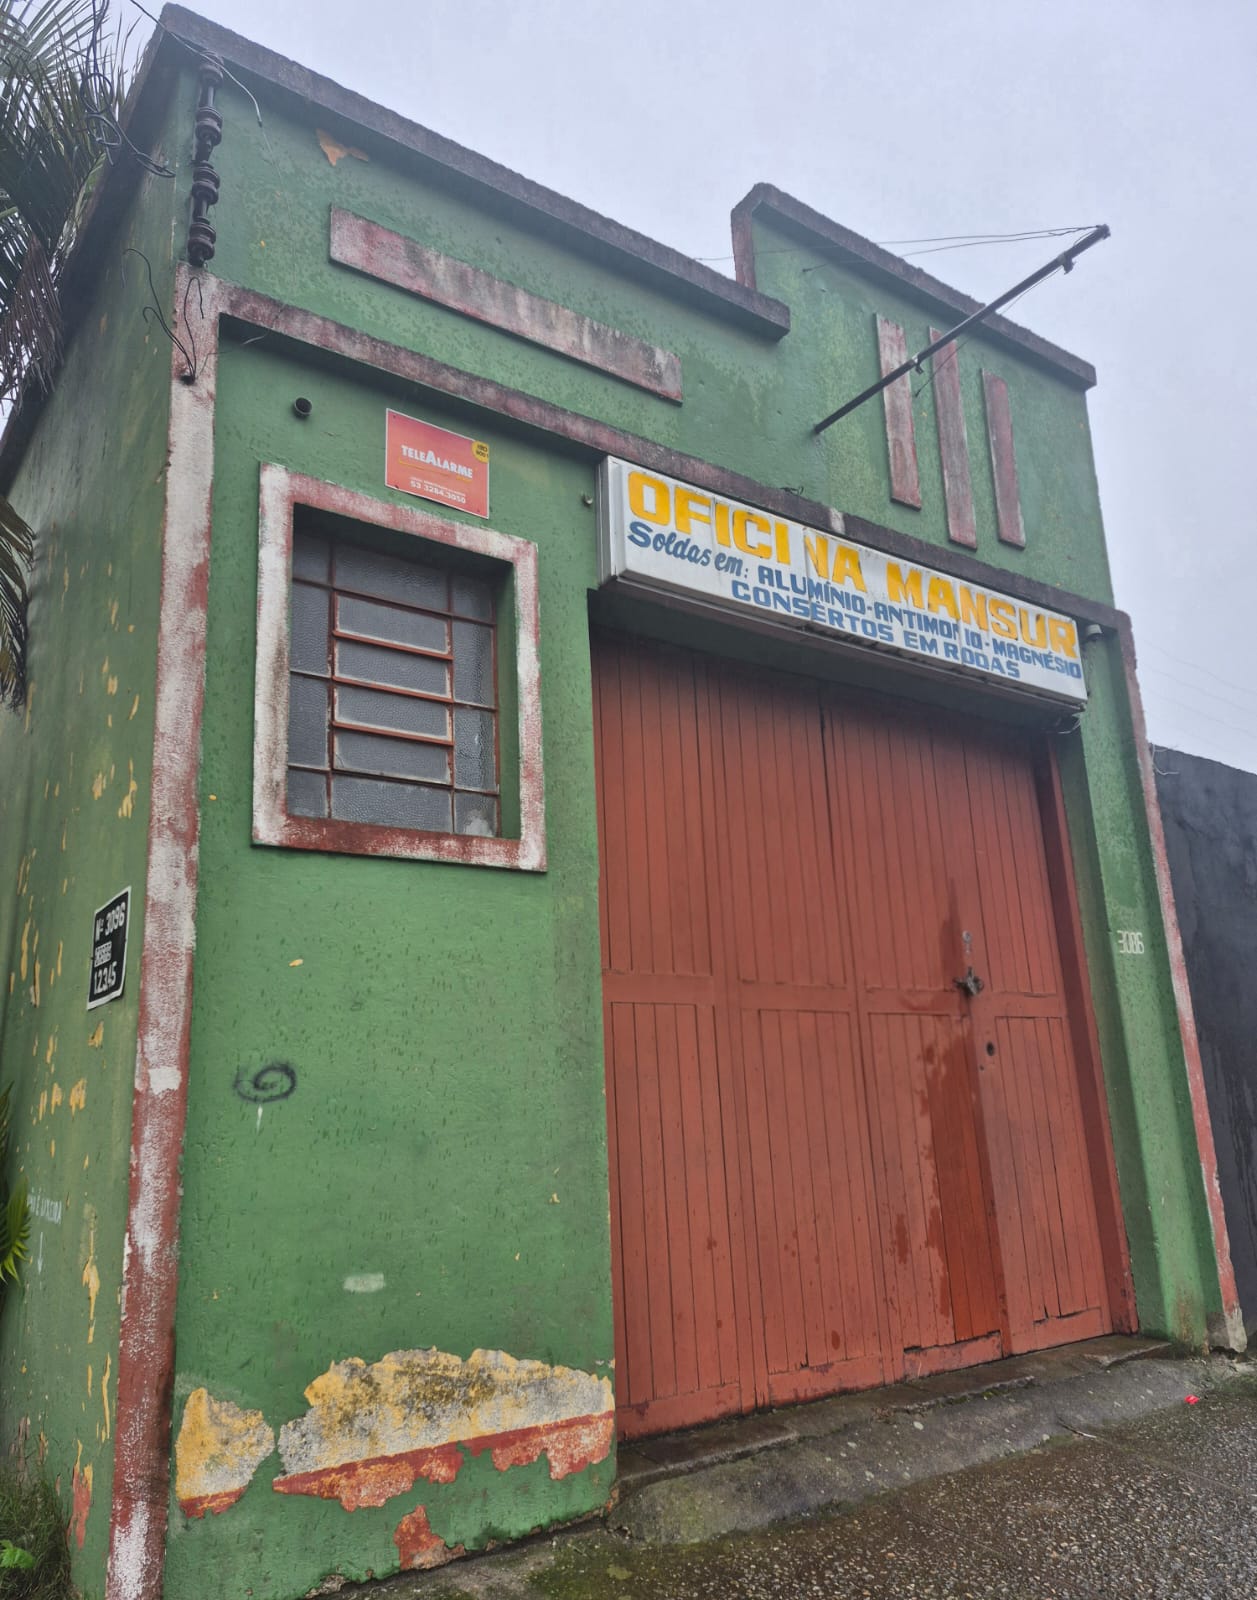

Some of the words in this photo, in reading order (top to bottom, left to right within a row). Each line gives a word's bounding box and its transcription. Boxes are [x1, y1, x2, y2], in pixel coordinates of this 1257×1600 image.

[627, 521, 712, 566] Soldas
[627, 470, 868, 593] OFICINA
[886, 560, 1078, 659] MANSUR
[903, 630, 939, 655] EM
[943, 641, 1020, 678] RODAS
